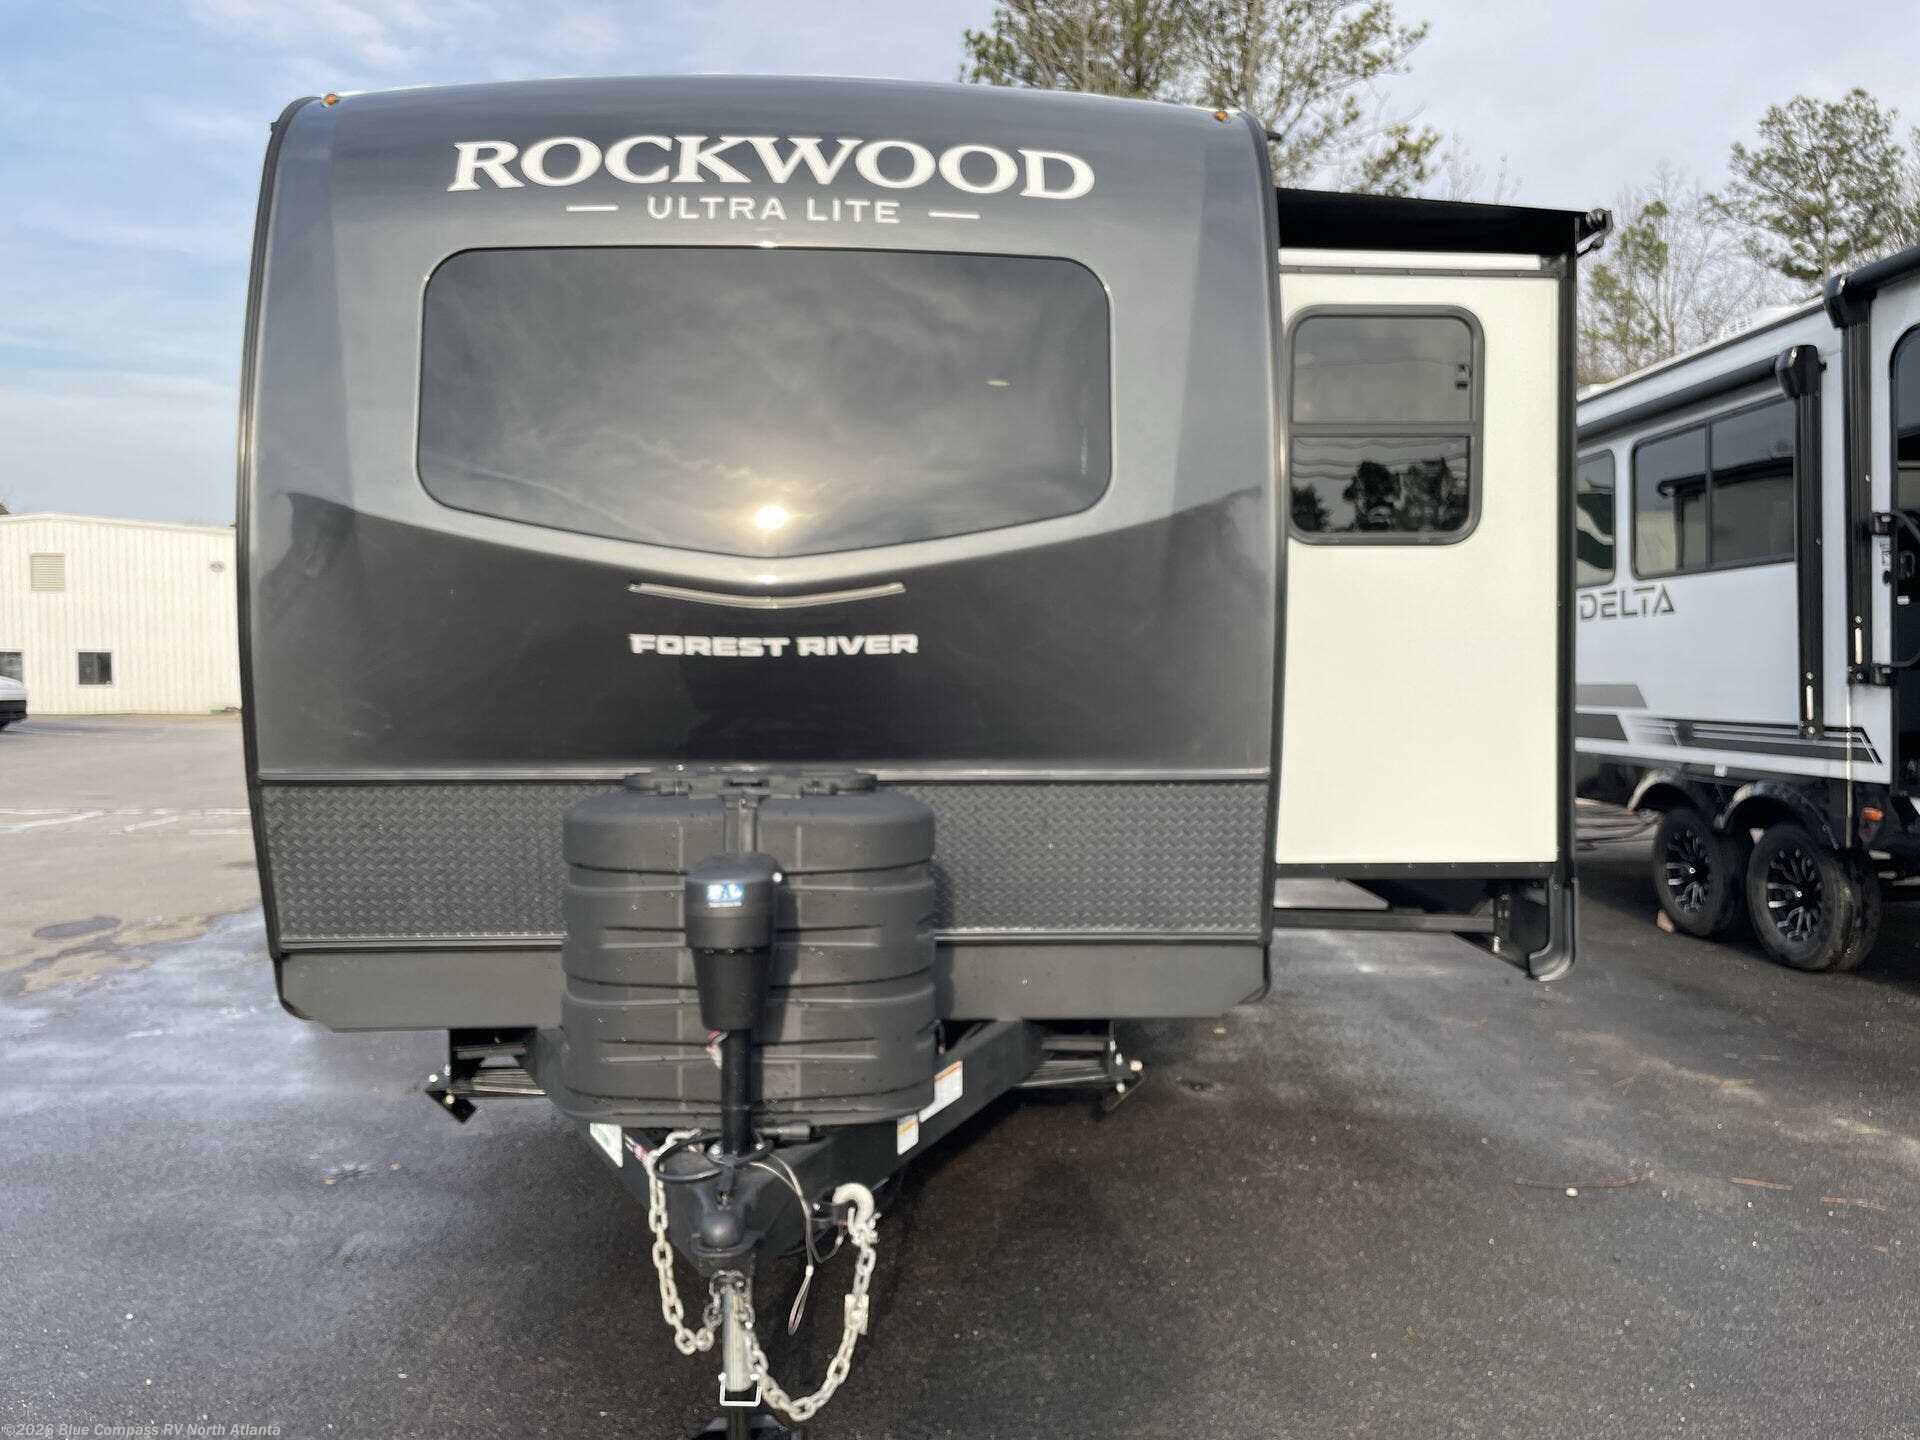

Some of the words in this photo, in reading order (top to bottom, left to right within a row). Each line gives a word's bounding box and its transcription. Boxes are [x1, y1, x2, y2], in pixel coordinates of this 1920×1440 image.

[447, 135, 1095, 200] ROCKWOOD
[646, 196, 786, 222] ULTRA
[806, 198, 901, 224] LITE
[1579, 584, 1675, 620] DELTA
[628, 633, 790, 657] FOREST
[797, 633, 919, 657] RIVER
